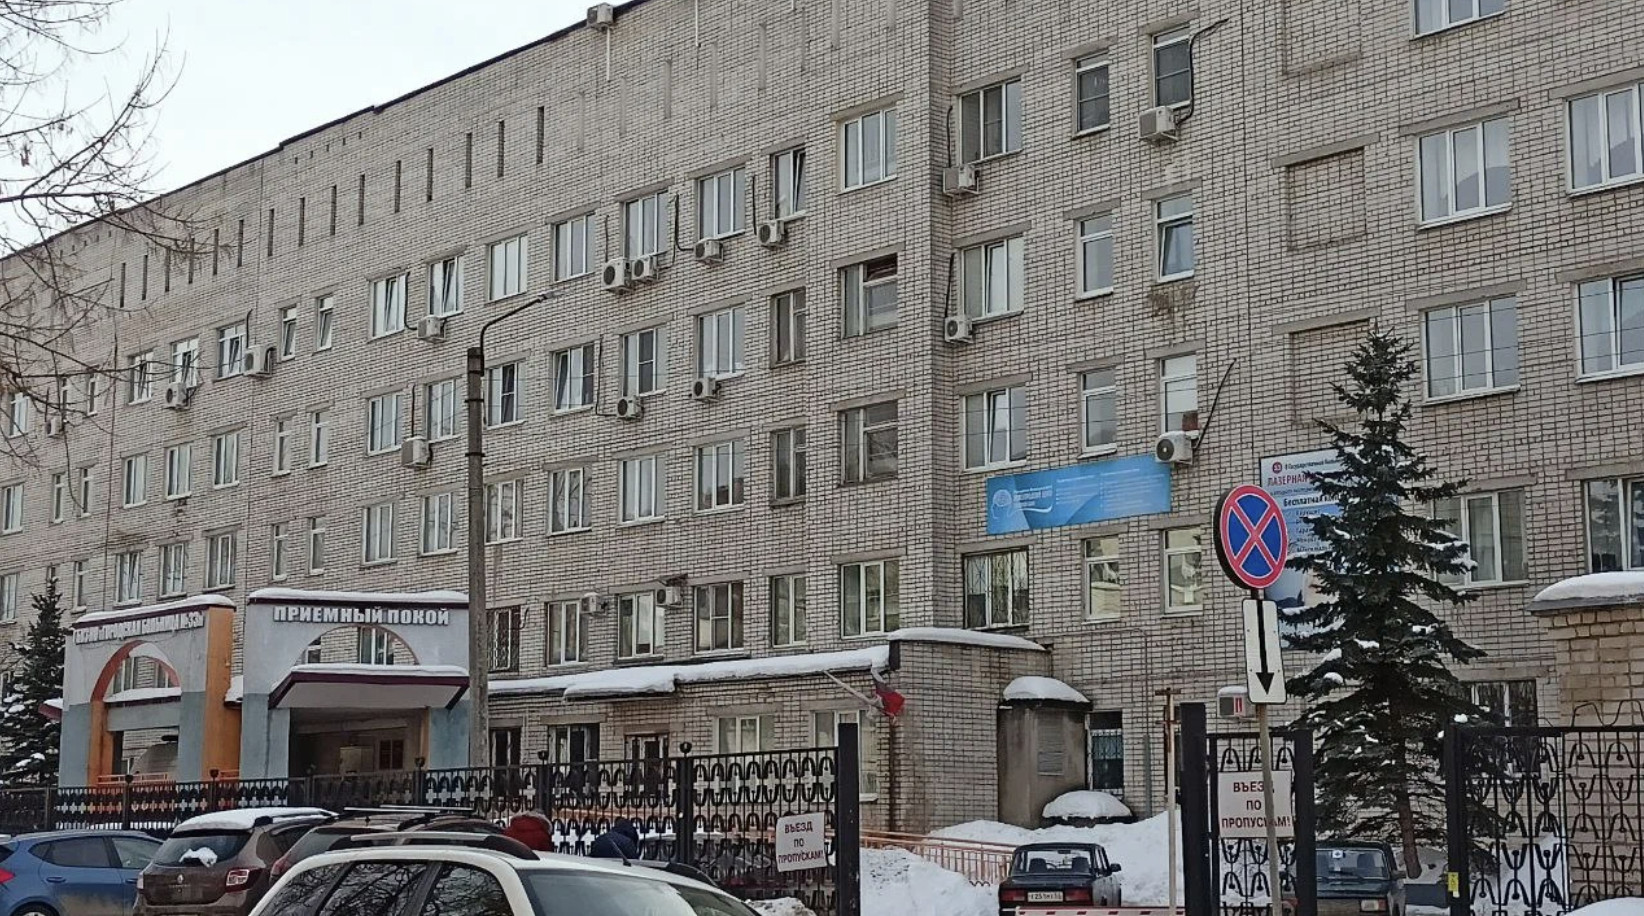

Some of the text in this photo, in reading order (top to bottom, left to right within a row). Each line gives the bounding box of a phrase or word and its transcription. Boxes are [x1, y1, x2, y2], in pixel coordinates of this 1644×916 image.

[273, 606, 450, 625] ПРИЕМНЫЙ ПОКОЙ
[1233, 781, 1275, 793] ВЪЕЗ
[1246, 800, 1262, 811] ПО
[793, 838, 805, 848] ПО
